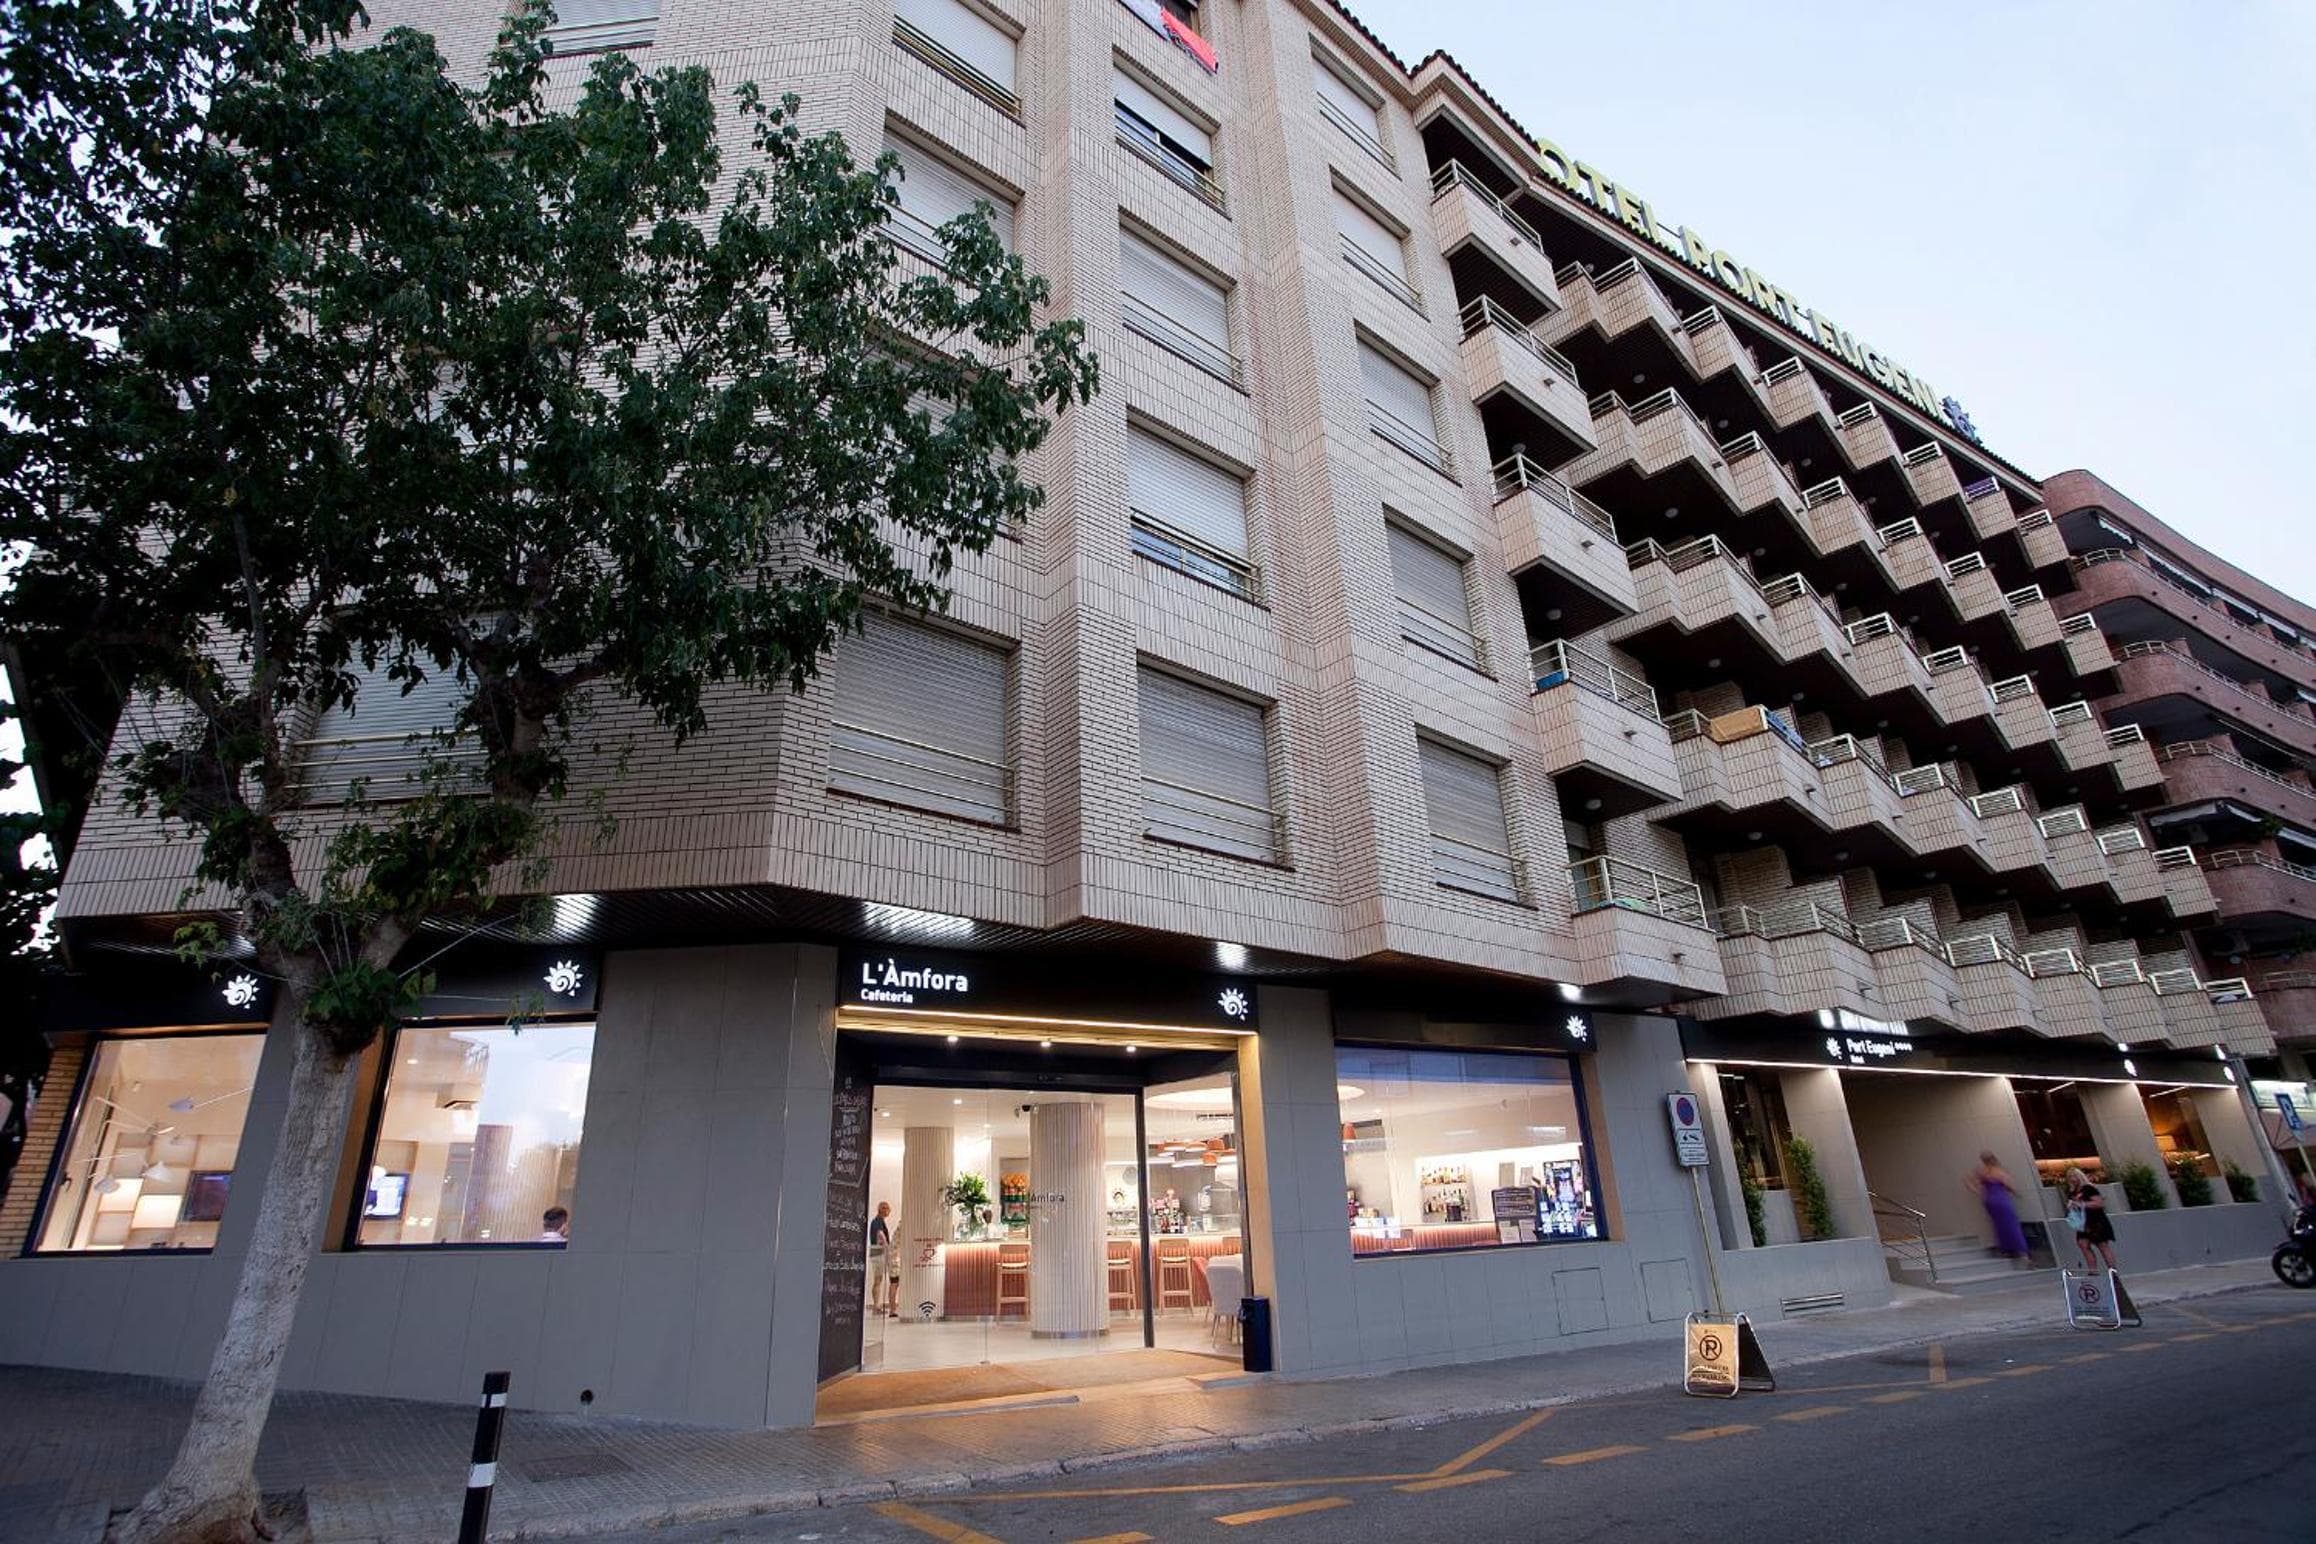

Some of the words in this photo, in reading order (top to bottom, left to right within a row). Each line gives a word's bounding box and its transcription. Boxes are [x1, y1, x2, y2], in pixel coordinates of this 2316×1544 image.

[1679, 225, 1801, 333] PORT
[862, 958, 969, 992] L'Àmfora
[861, 988, 914, 1004] Cafeteria
